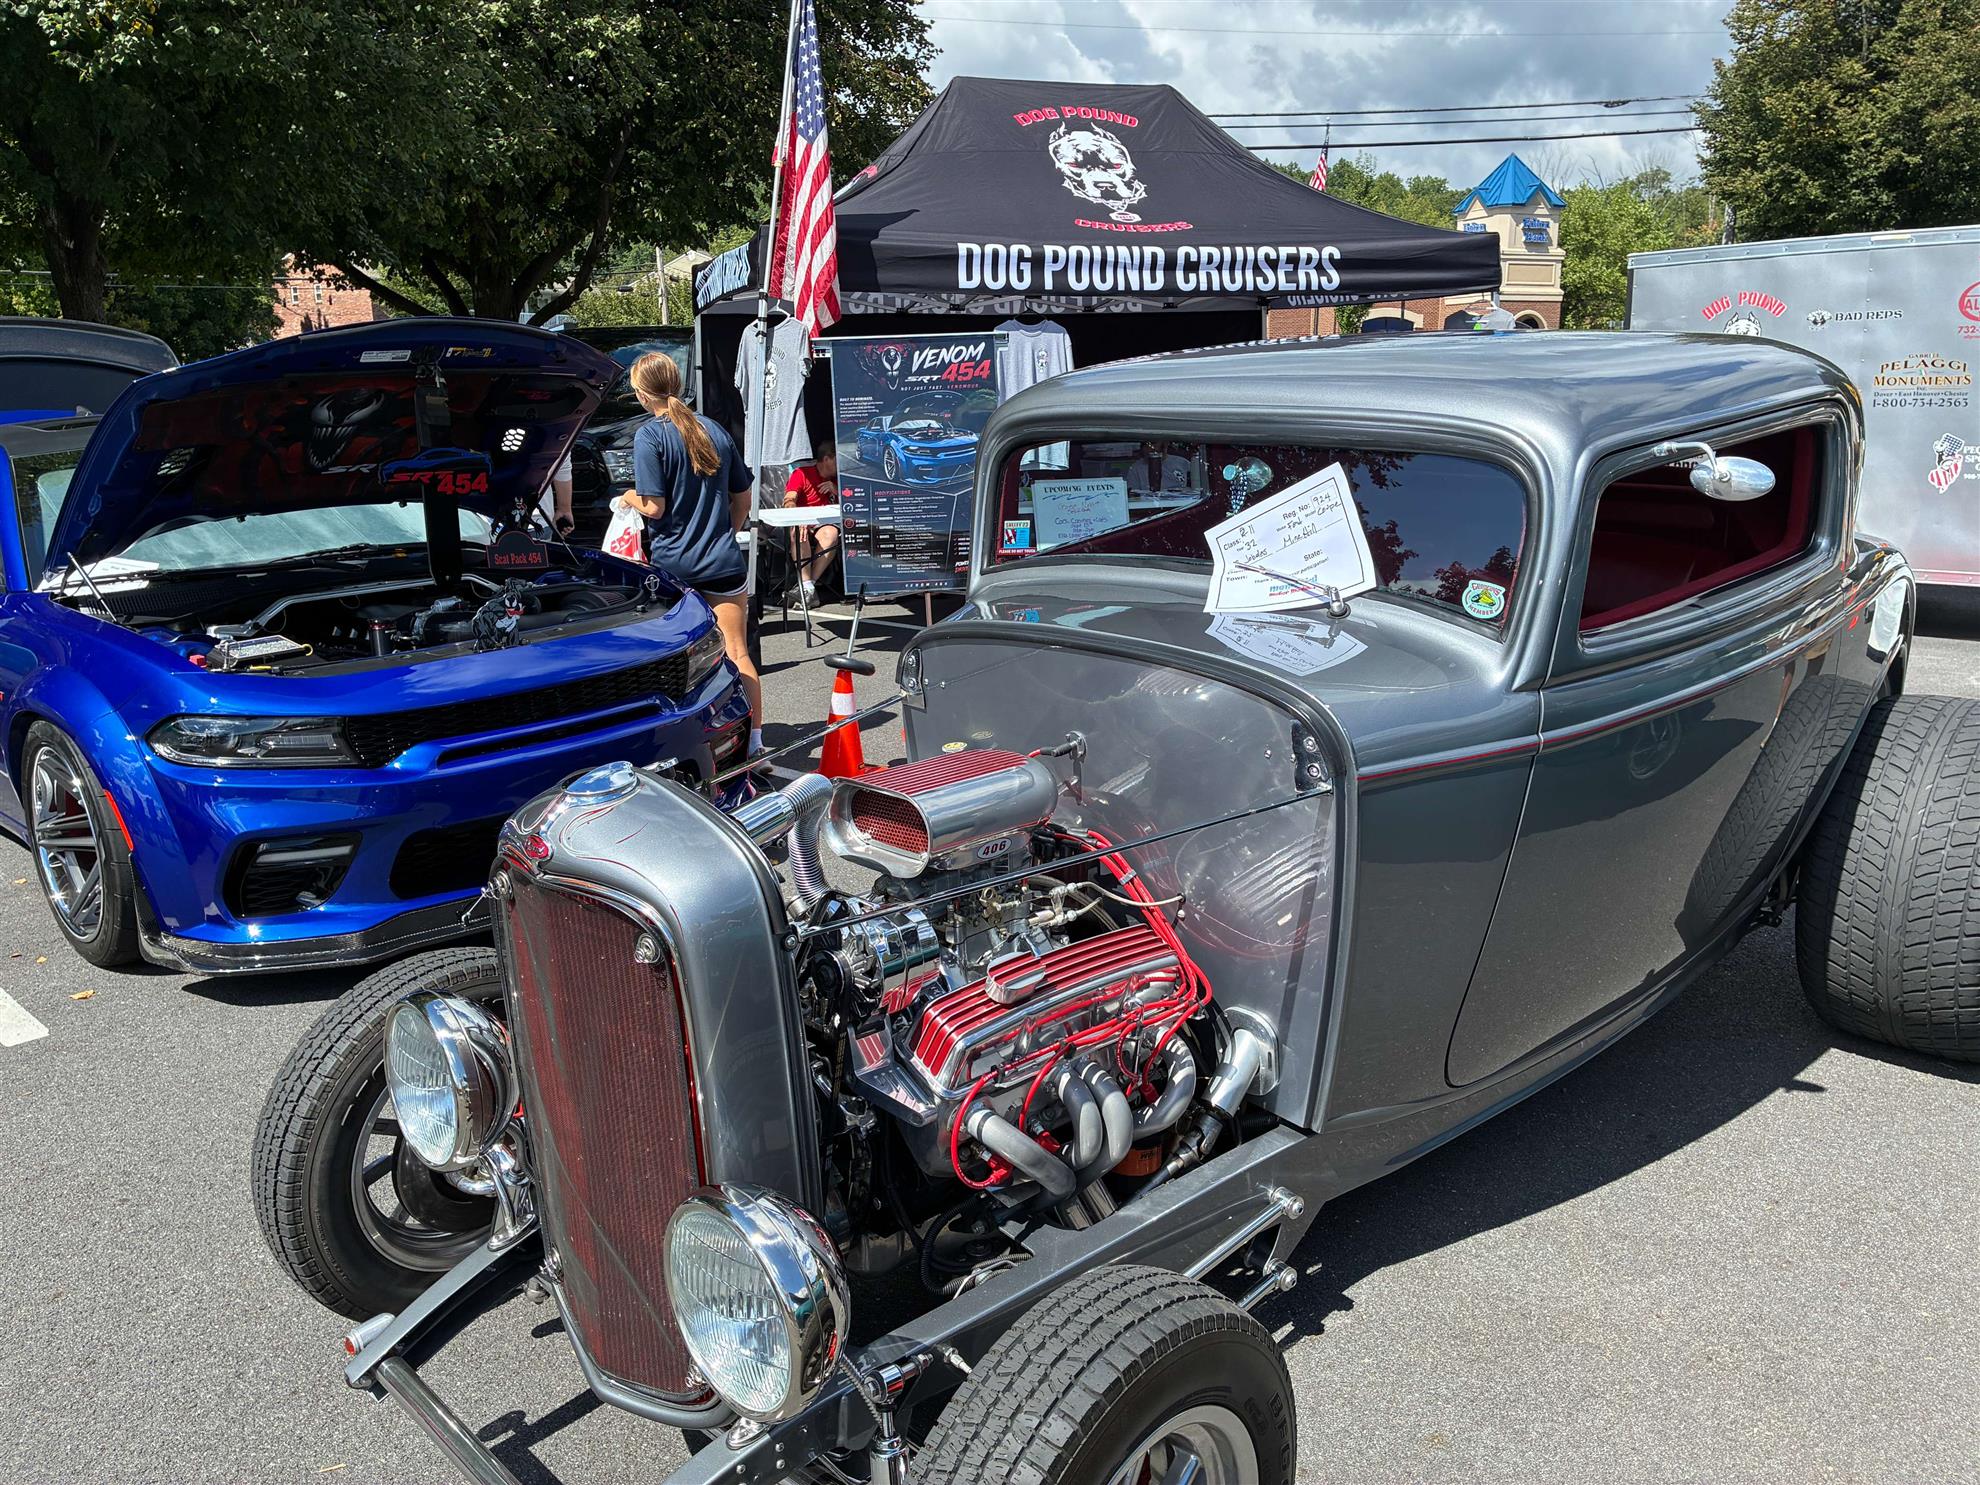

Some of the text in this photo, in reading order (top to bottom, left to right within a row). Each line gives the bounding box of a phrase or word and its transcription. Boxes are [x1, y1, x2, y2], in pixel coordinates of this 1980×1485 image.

[1013, 105, 1139, 128] DOG POUND
[1074, 218, 1194, 233] CRUISERS
[956, 242, 1341, 292] DOG POUND CRUISERS
[1702, 290, 1787, 321] DOG POUND
[1965, 298, 1980, 311] AL
[1835, 309, 1903, 322] BAD REPS
[1958, 325, 1980, 334] 732-
[911, 341, 986, 374] VENOM
[905, 359, 991, 383] SRT 454
[1880, 359, 1967, 374] PELAGGI
[1873, 375, 1972, 387] MONUMENTS
[321, 463, 378, 474] SR
[437, 472, 488, 495] 454
[1044, 484, 1115, 494] UPCOMING EVENTS
[494, 551, 542, 565] Scat Pack 454
[983, 840, 1007, 856] 406
